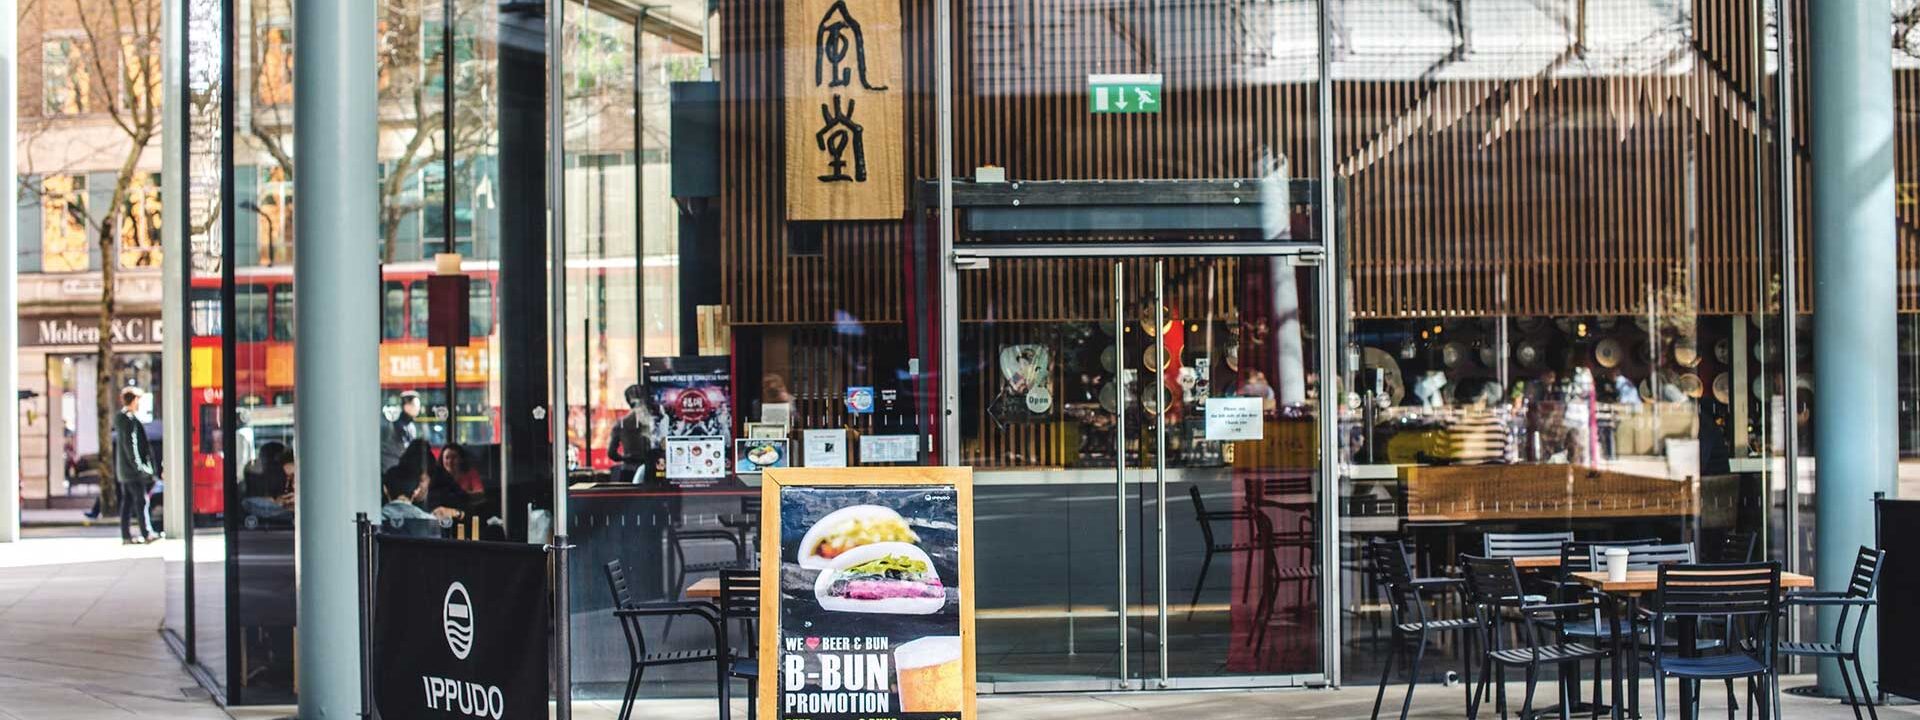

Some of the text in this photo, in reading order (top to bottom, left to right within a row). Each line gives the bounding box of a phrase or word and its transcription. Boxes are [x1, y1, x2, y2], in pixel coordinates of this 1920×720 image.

[38, 318, 143, 344] Molten&C
[1029, 397, 1048, 405] Open
[785, 637, 889, 651] WE BEER & BUN
[785, 653, 889, 692] B-BUN
[422, 676, 504, 720] IPPUDO
[785, 692, 889, 714] PROMOTION
